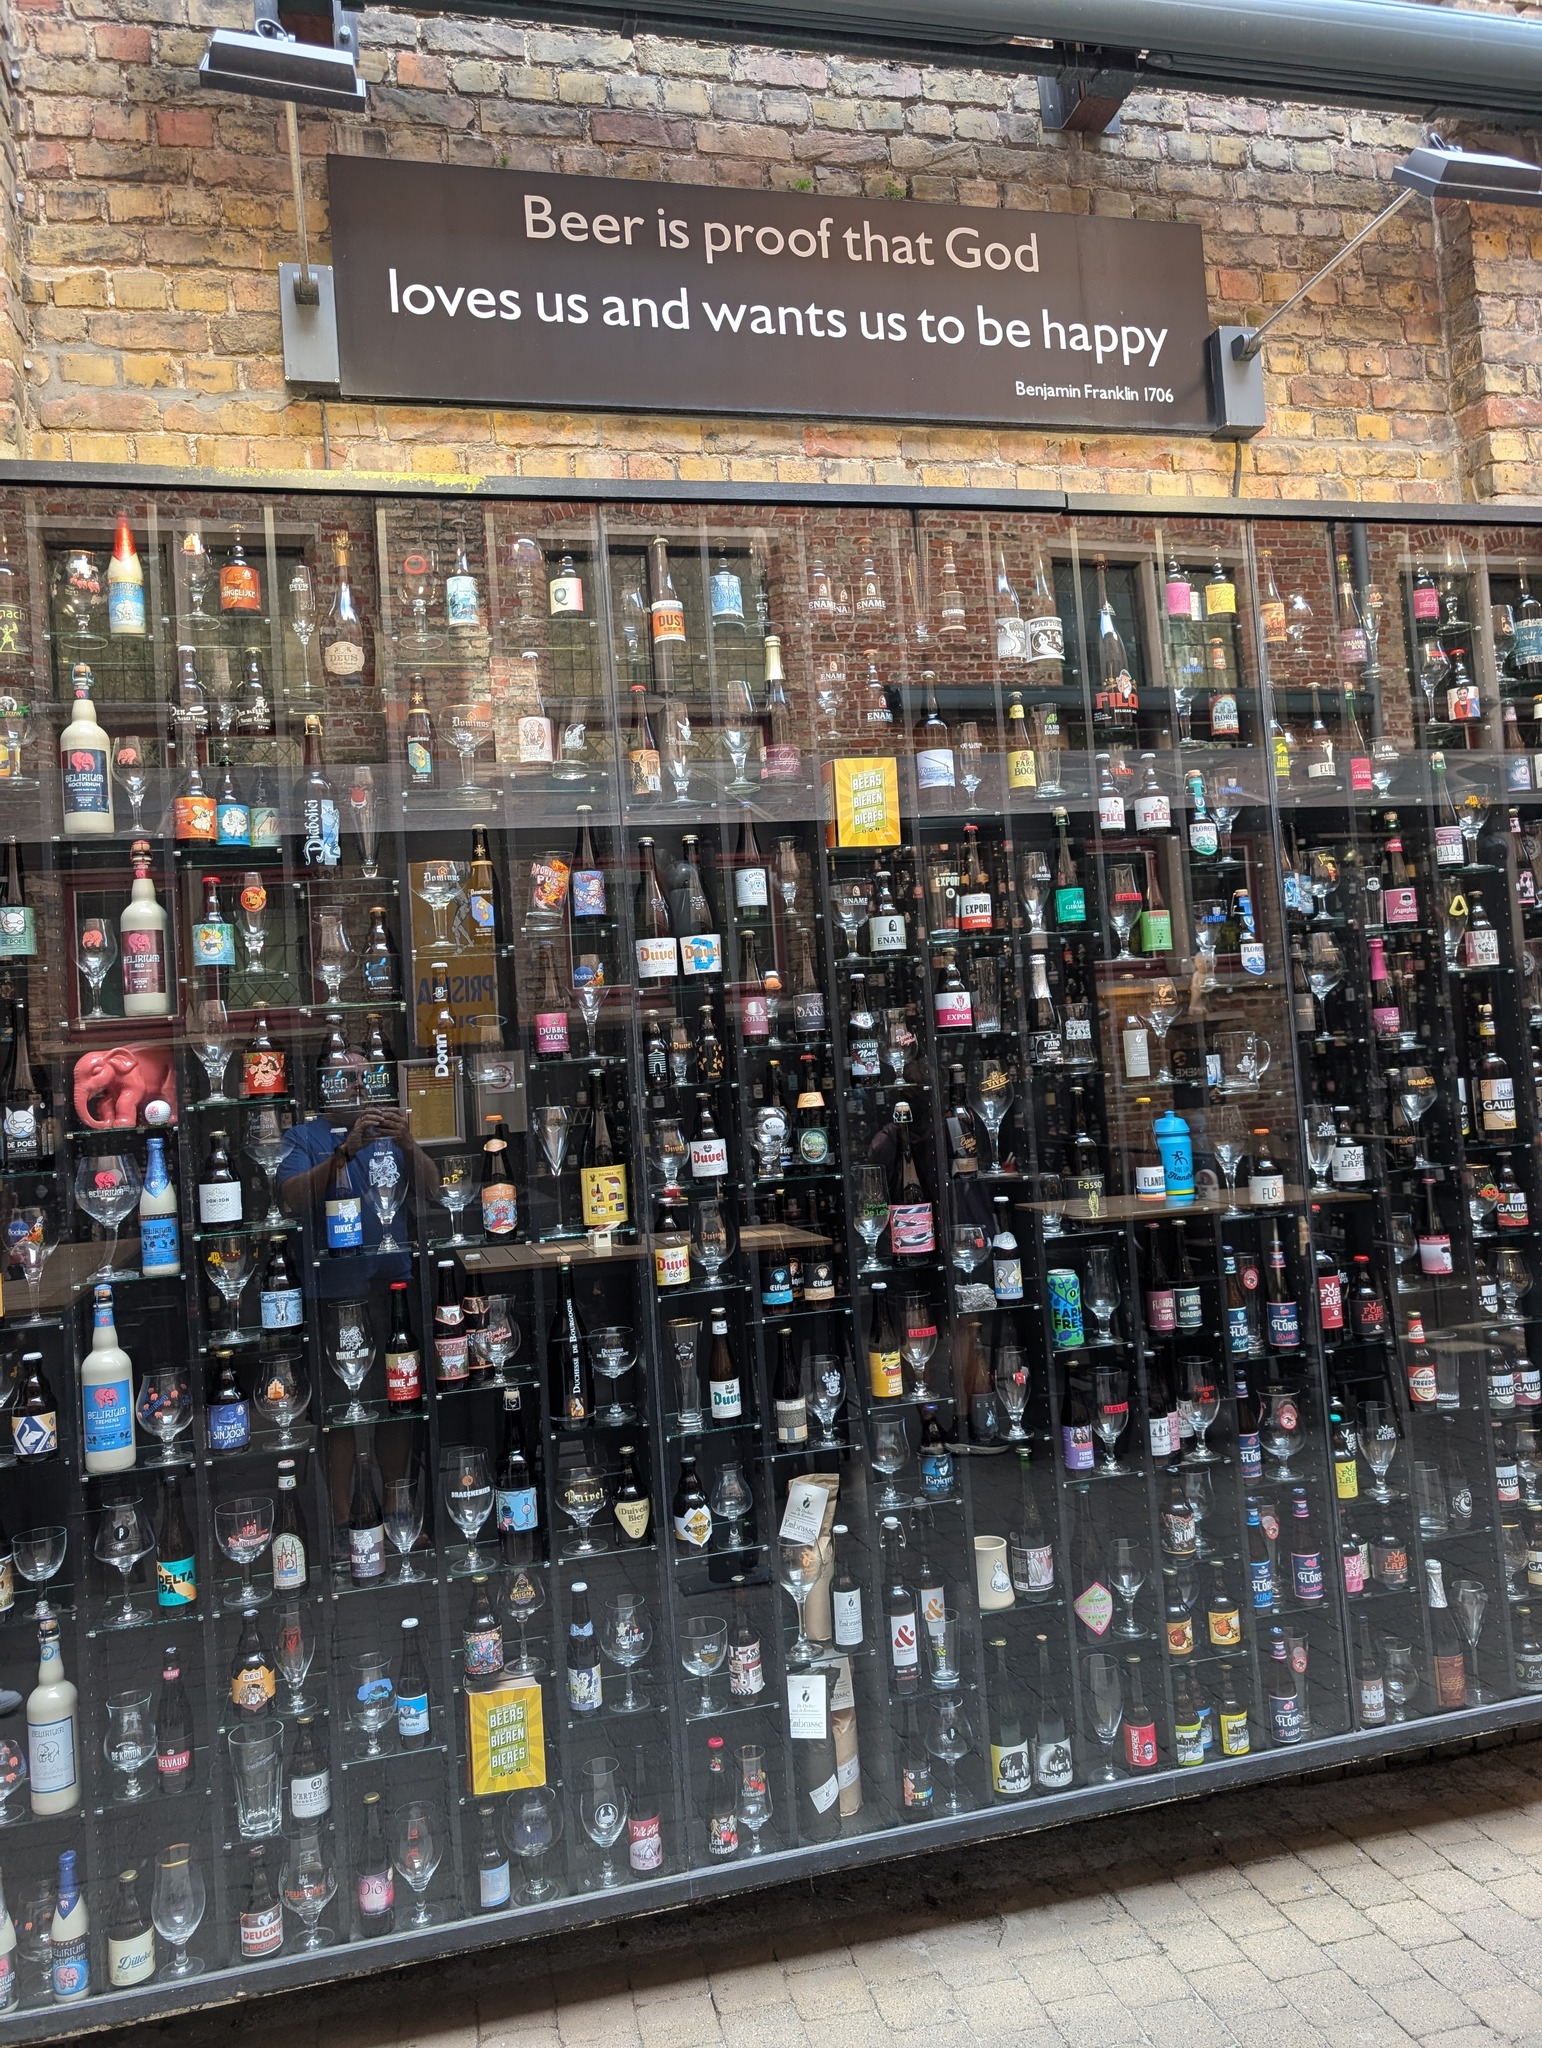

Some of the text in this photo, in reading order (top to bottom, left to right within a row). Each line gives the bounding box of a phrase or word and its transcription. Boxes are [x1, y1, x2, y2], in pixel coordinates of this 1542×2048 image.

[524, 194, 1039, 274] Beer is proof that God
[389, 269, 1168, 366] loves us and wants us to be happy
[1015, 381, 1174, 403] Benjamin Franklin 1706
[554, 588, 569, 606] Q
[809, 600, 837, 610] ENAME
[856, 600, 886, 610] ENAME
[330, 653, 358, 662] DEUS
[452, 716, 490, 728] Dominus
[66, 774, 104, 784] DELIRIUM
[852, 775, 882, 790] BEERS
[853, 793, 883, 807] BIEREN
[854, 811, 884, 825] BIERES
[303, 805, 323, 869] Diabolici
[424, 872, 460, 882] Dominus
[936, 876, 960, 886] EXPORT
[948, 889, 953, 898] 8
[843, 897, 868, 905] ENAME
[965, 903, 990, 915] EXPORT
[878, 936, 906, 944] ENAME
[124, 954, 160, 964] DELIRIUM
[640, 947, 676, 961] Duvel
[539, 1027, 566, 1035] DUBBEL
[673, 1042, 693, 1050] Duvel
[15, 1139, 36, 1147] POES
[664, 1145, 685, 1153] Duvel
[693, 1149, 724, 1164] Duvel
[1078, 1180, 1102, 1189] Fasso
[88, 1188, 122, 1198] DELIRIUM
[334, 1224, 352, 1234] DIKKE
[668, 1269, 682, 1278] 666
[770, 1284, 789, 1292] Elfique
[813, 1280, 833, 1288] Elfique
[566, 1298, 576, 1343] BOURGOGNE
[1273, 1319, 1299, 1331] FLORIS
[1277, 1330, 1296, 1340] Kriek
[336, 1349, 369, 1360] DIKKE JAN
[572, 1344, 578, 1354] DE
[389, 1376, 418, 1388] DIKKE JAN
[87, 1408, 127, 1421] DELIRIUM
[565, 1488, 604, 1504] Duivel
[621, 1504, 647, 1517] Duivels
[784, 1520, 817, 1535] Embrasse
[369, 1552, 380, 1562] JAN
[159, 1571, 193, 1586] DELTA
[159, 1583, 176, 1595] IPA
[244, 1672, 259, 1681] DEO
[490, 1708, 523, 1728] BEERS
[491, 1728, 525, 1747] BIEREN
[1132, 1730, 1141, 1763] FERRE
[158, 1756, 187, 1768] DELVAUX
[491, 1751, 525, 1768] BIERES
